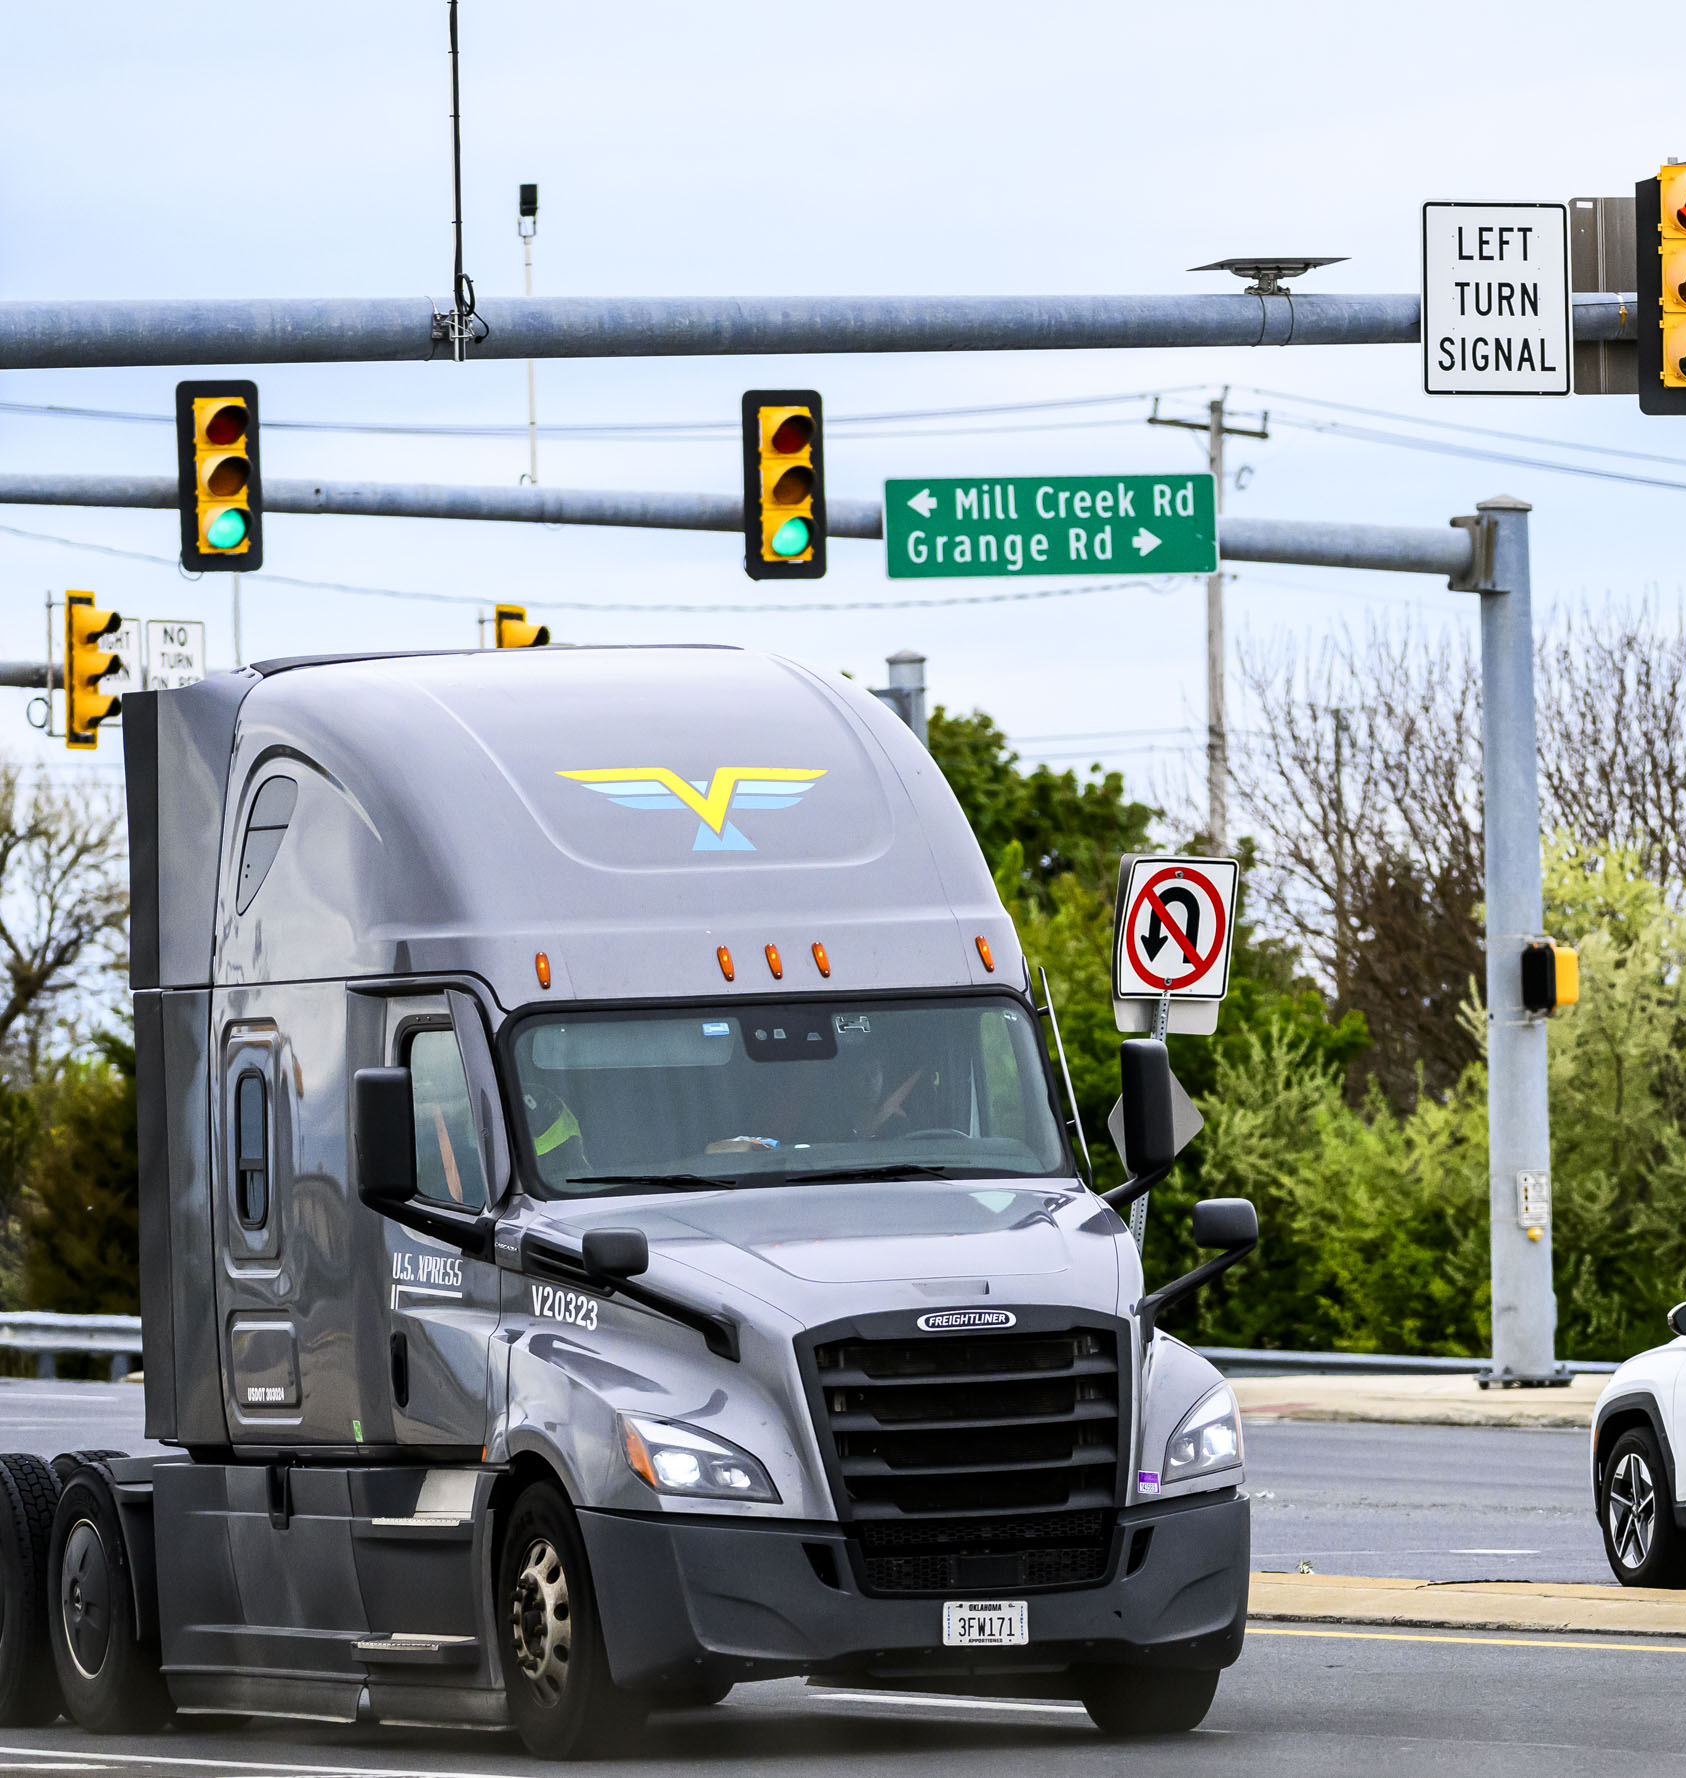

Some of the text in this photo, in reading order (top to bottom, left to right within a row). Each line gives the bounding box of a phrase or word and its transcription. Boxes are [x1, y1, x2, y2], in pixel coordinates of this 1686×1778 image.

[1458, 226, 1533, 261] LEFT
[1454, 281, 1539, 317] TURN
[1438, 336, 1557, 372] SIGNAL
[955, 481, 1195, 520] Mill Creek Rd
[907, 525, 1113, 571] Grange Rd
[101, 631, 130, 650] IGHT
[163, 626, 187, 647] NO
[161, 651, 193, 670] TURN
[392, 1252, 463, 1287] U.S. XPRESS
[531, 1284, 598, 1331] V20323
[929, 1313, 1006, 1326] FREIGHTLINER
[247, 1387, 265, 1402] USDOT
[958, 1617, 1015, 1637] 3FW171
